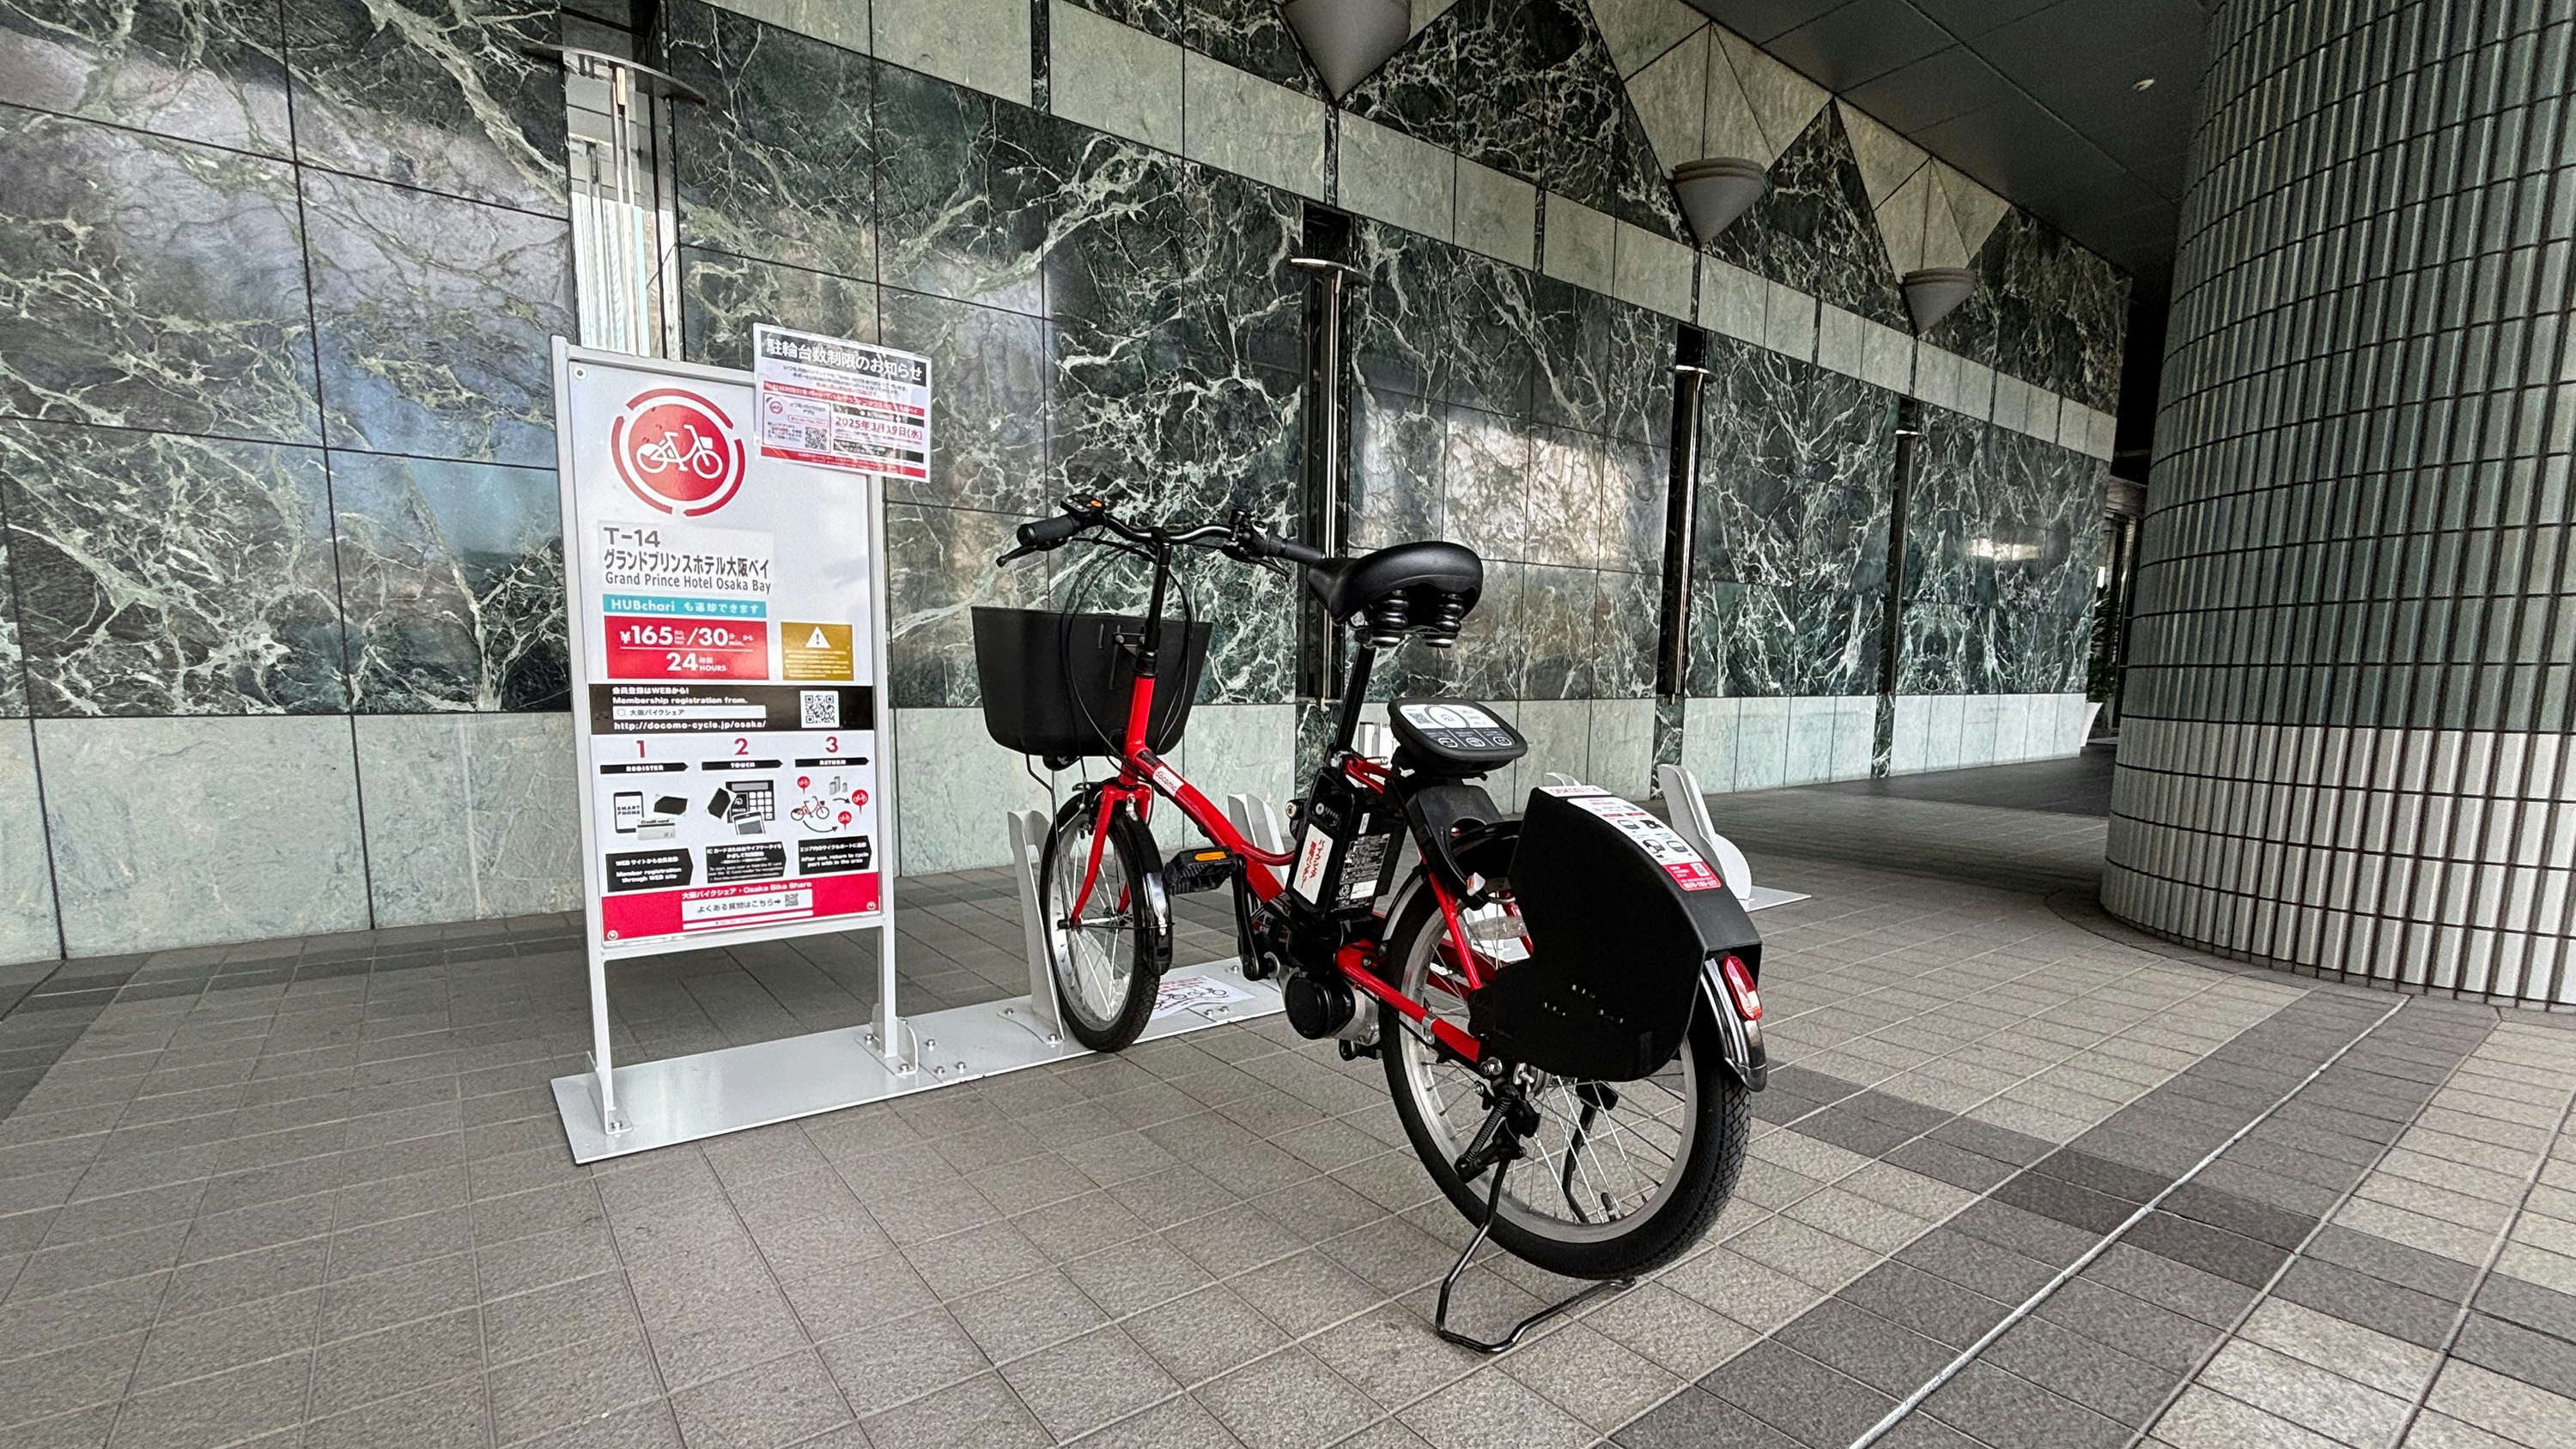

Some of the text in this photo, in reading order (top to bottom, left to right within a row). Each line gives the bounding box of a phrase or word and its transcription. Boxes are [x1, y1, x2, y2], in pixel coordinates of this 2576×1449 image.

[767, 338, 923, 380] 駐輪台数制限のお知らせ
[604, 527, 660, 547] T-14
[604, 549, 769, 579] グランドプリンスホテル大阪ベイ
[605, 572, 771, 595] Grand Prince Hotel Osaka Bay
[611, 599, 759, 615] HUBchari も返却できます
[666, 652, 698, 670] 24
[614, 720, 767, 731] http://docomo-cycle.jp/osaka/
[636, 740, 645, 758] 1
[734, 738, 749, 755] 2
[826, 737, 838, 753] 3
[1155, 770, 1176, 791] docomo
